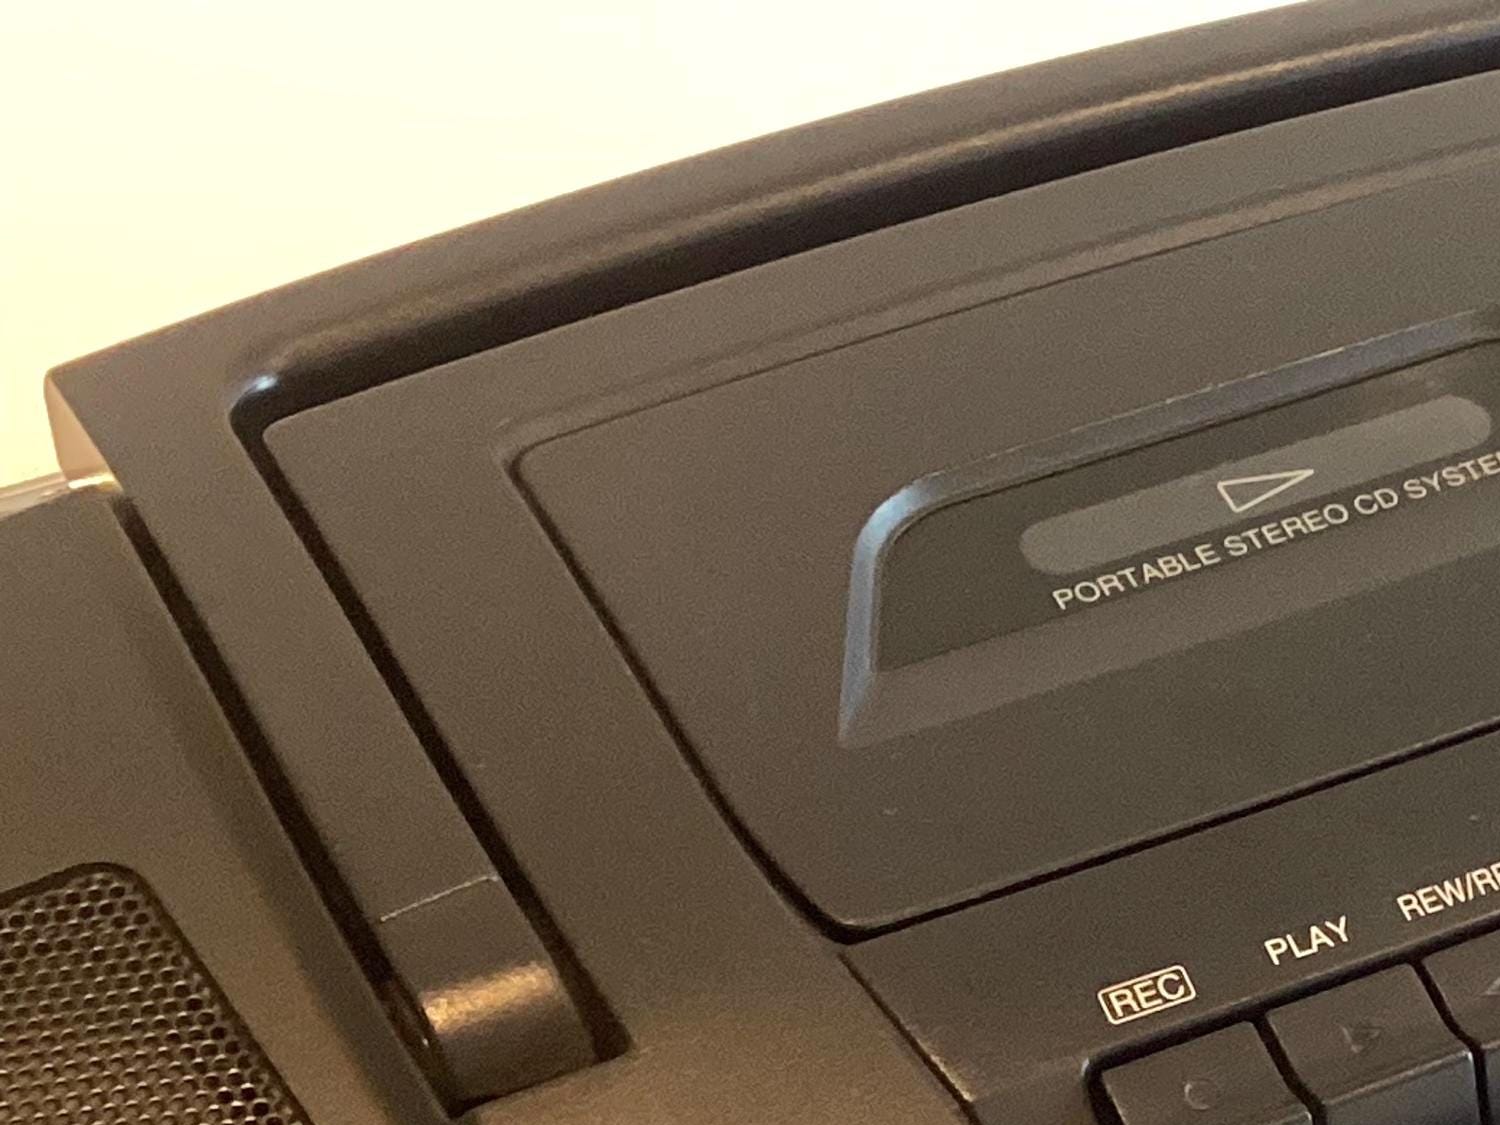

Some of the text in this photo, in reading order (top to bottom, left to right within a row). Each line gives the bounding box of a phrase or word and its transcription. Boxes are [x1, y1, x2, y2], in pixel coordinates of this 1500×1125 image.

[1052, 544, 1222, 611] PORTABLE
[1223, 504, 1350, 558] STEREO
[1353, 488, 1399, 517] CD
[1264, 916, 1349, 966] PLAY
[1108, 973, 1186, 1018] REC
